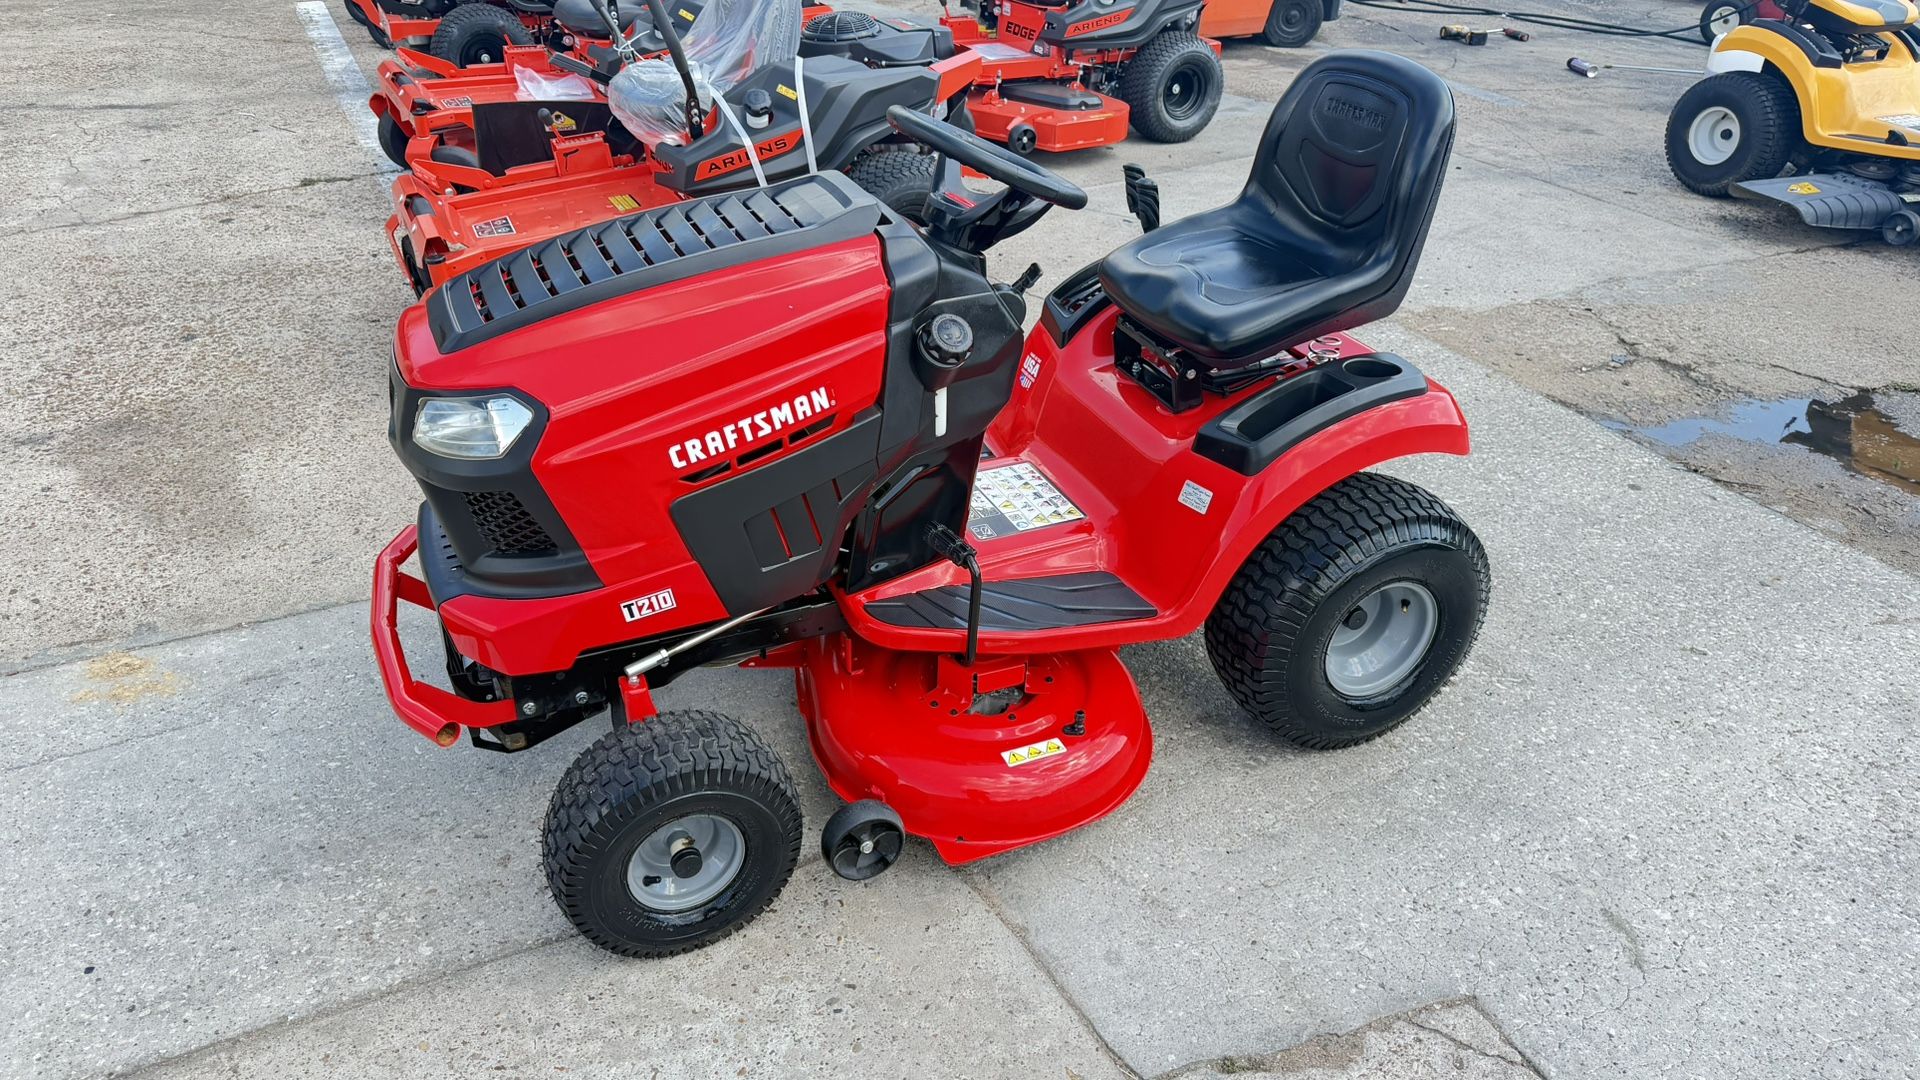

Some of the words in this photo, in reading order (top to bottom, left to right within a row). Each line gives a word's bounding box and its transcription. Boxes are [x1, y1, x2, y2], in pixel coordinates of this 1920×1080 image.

[1005, 21, 1036, 40] EDGE
[1073, 14, 1121, 32] ARIENS
[708, 138, 788, 173] ARINS
[1023, 355, 1040, 378] USA
[668, 386, 830, 469] CRAFTSMAN
[622, 591, 673, 619] T210
